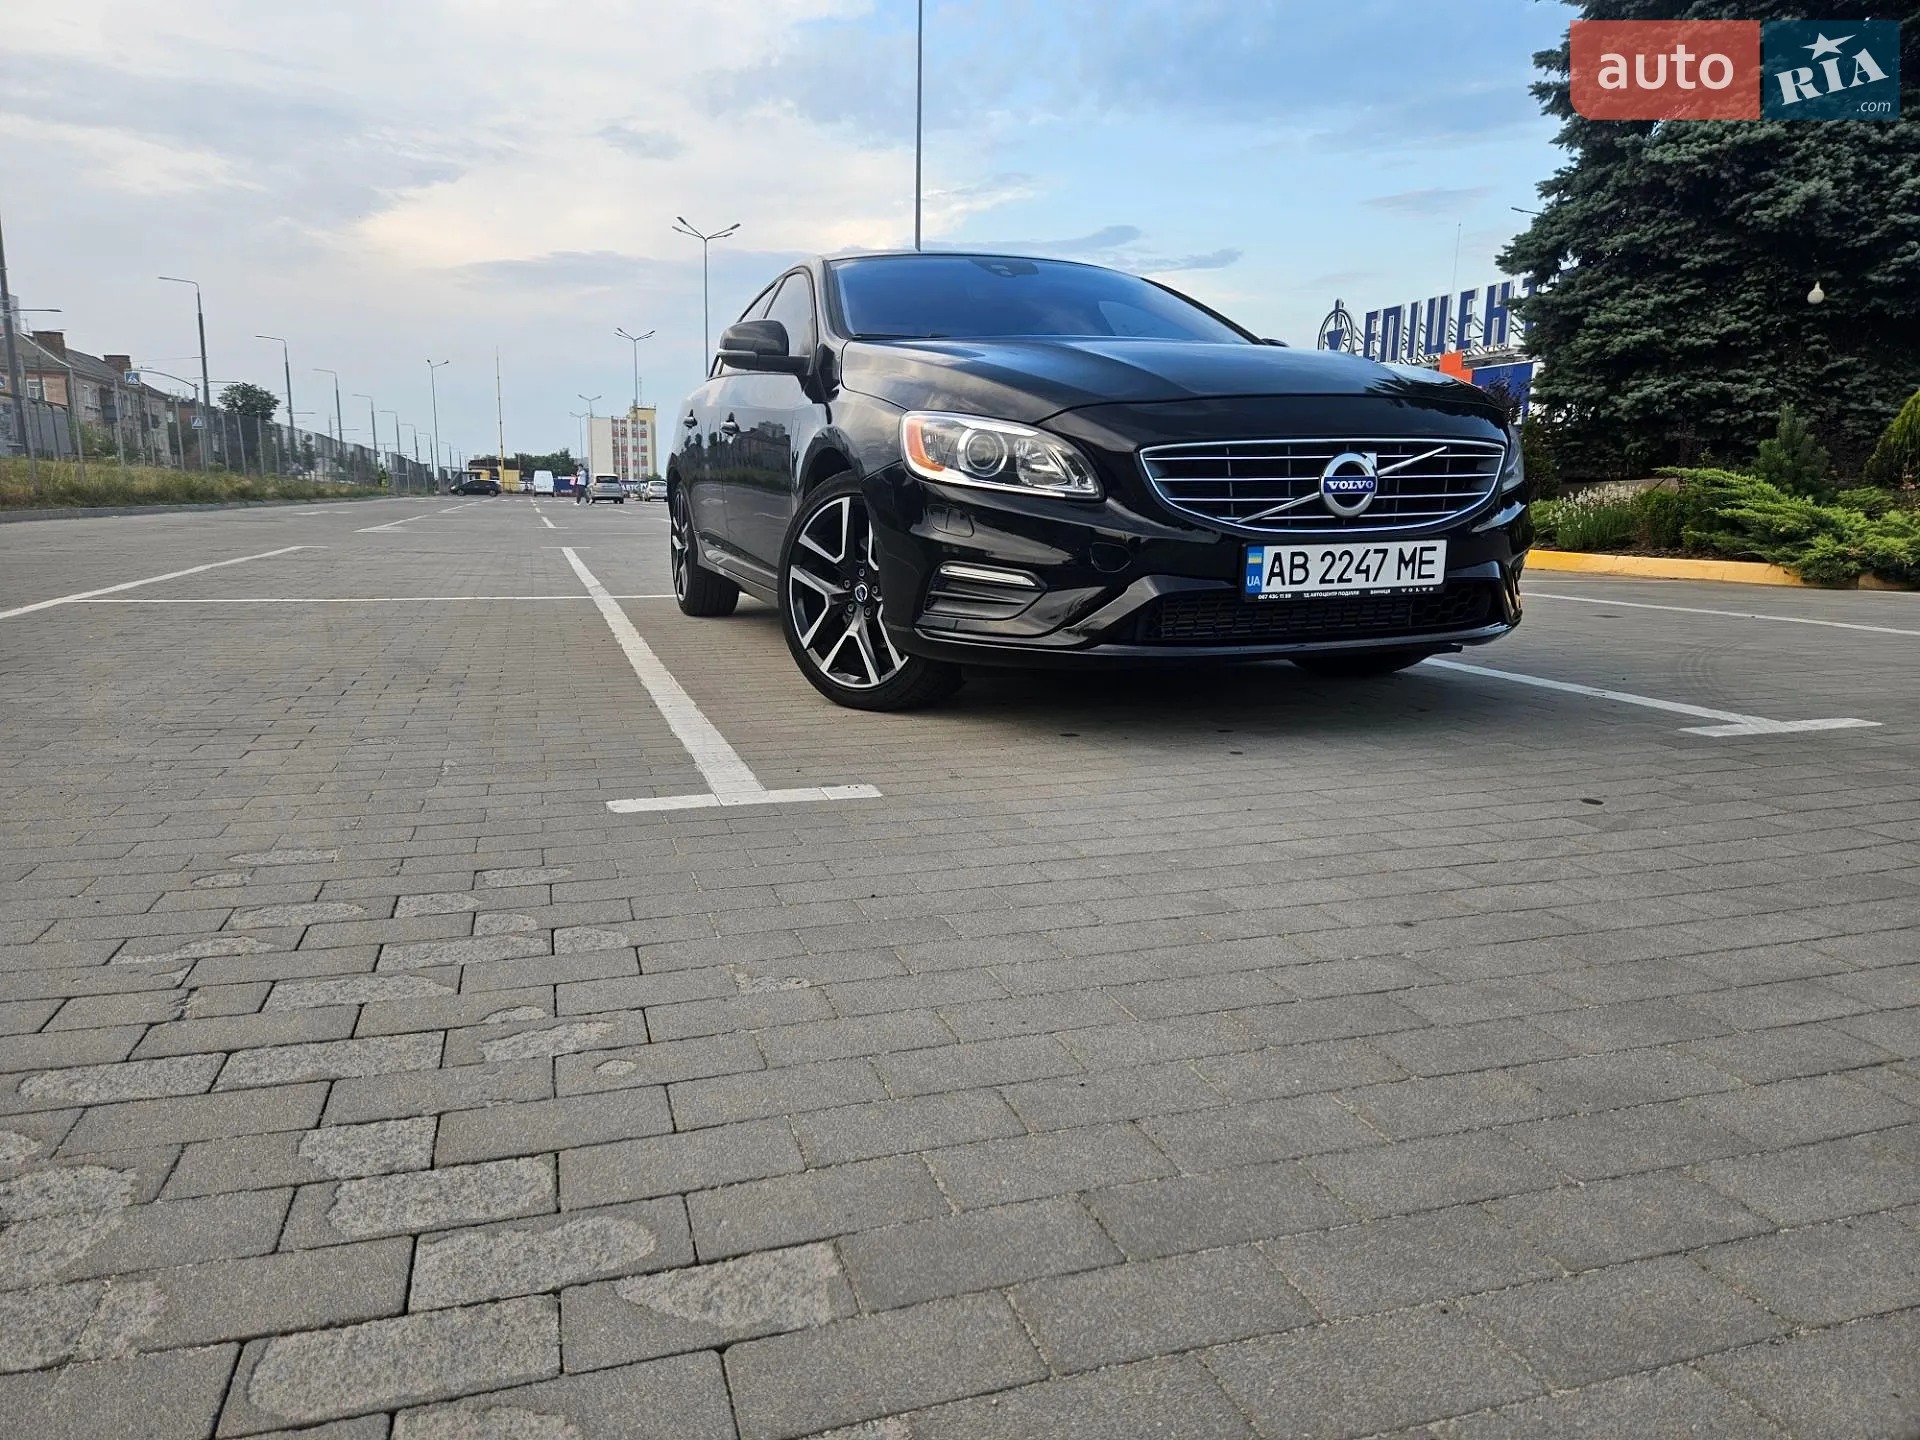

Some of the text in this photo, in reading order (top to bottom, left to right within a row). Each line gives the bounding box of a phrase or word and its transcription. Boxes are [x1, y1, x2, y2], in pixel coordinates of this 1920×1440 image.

[1326, 480, 1374, 490] VOLVO
[1266, 546, 1438, 586] AB 2247 ME
[1247, 575, 1261, 587] UA
